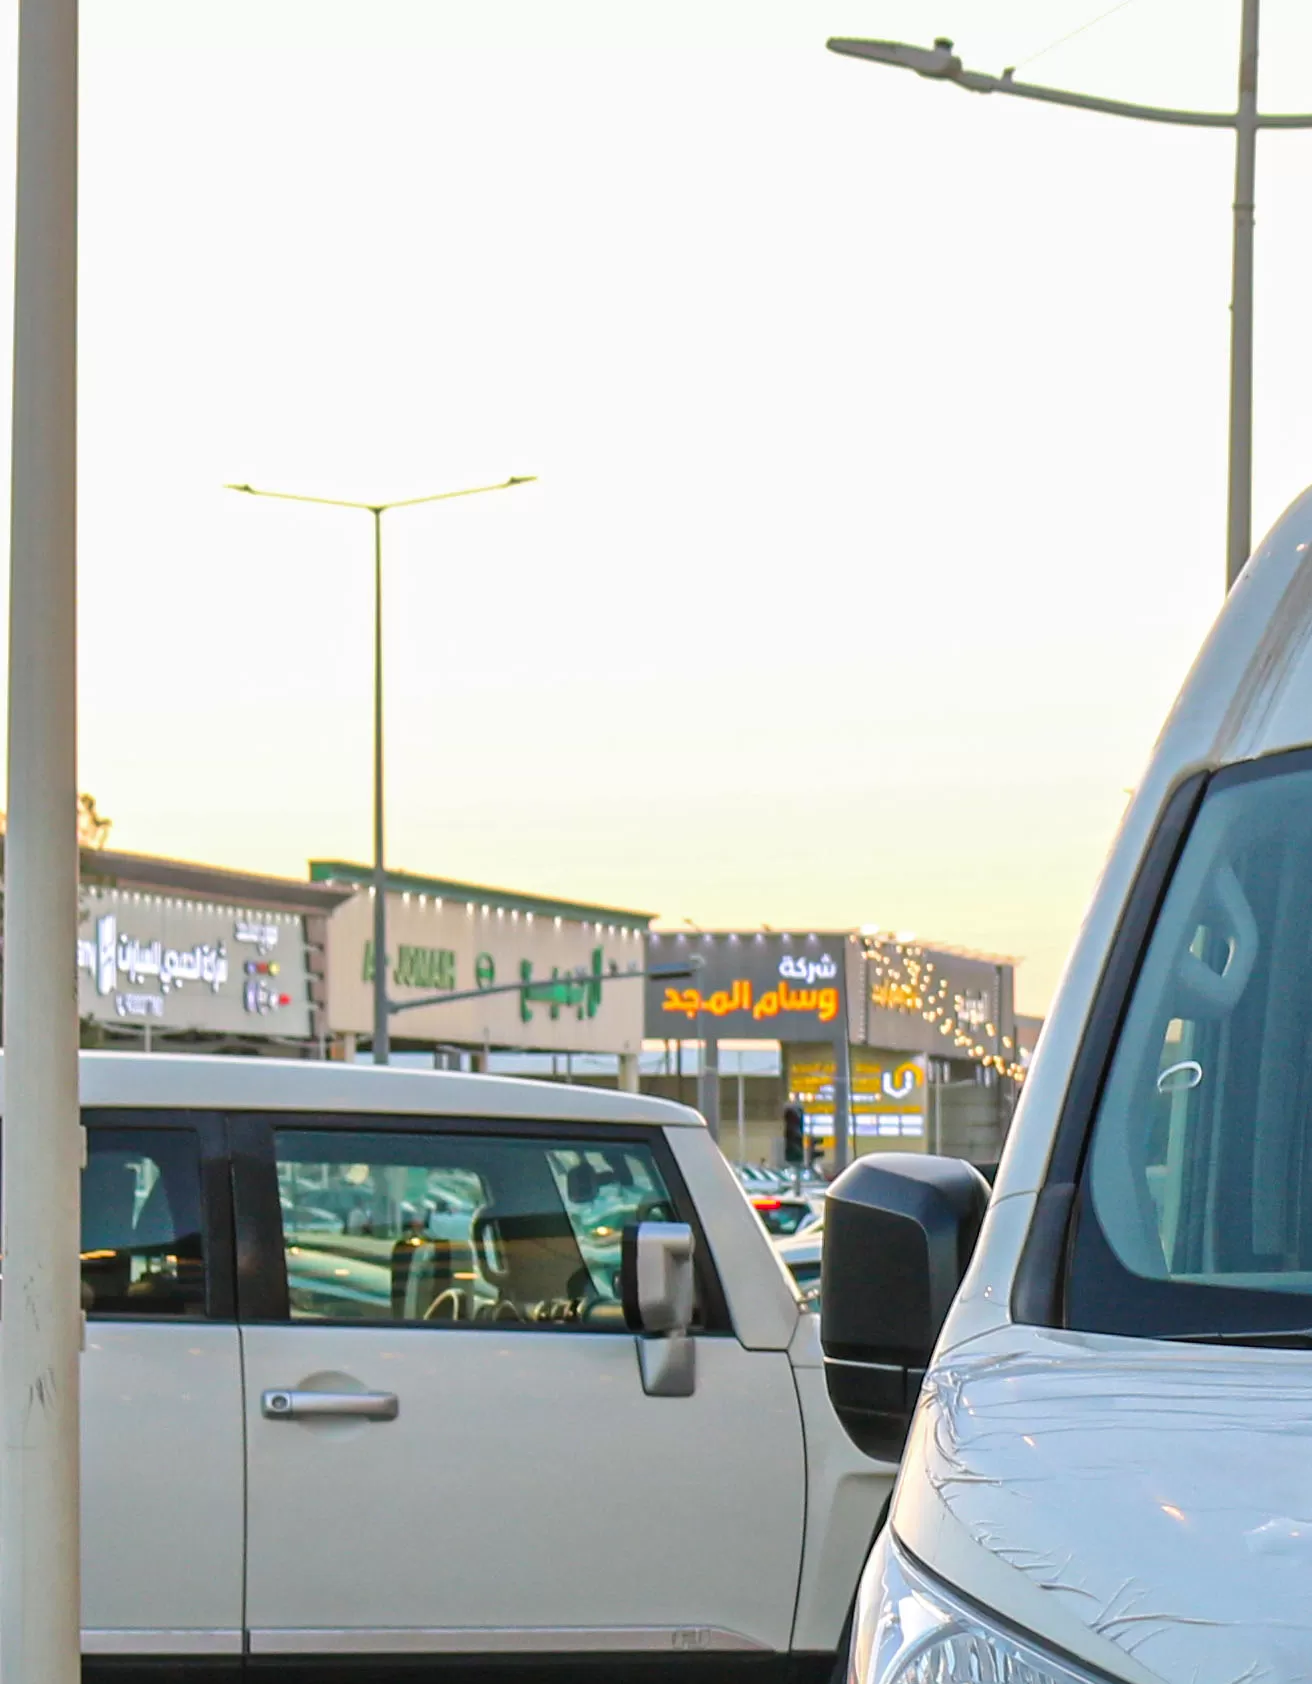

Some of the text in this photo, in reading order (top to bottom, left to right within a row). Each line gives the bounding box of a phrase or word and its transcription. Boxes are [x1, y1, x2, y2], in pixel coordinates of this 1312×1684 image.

[779, 952, 837, 984] شركة
[662, 979, 753, 1019] المجد
[754, 980, 839, 1022] وسام
